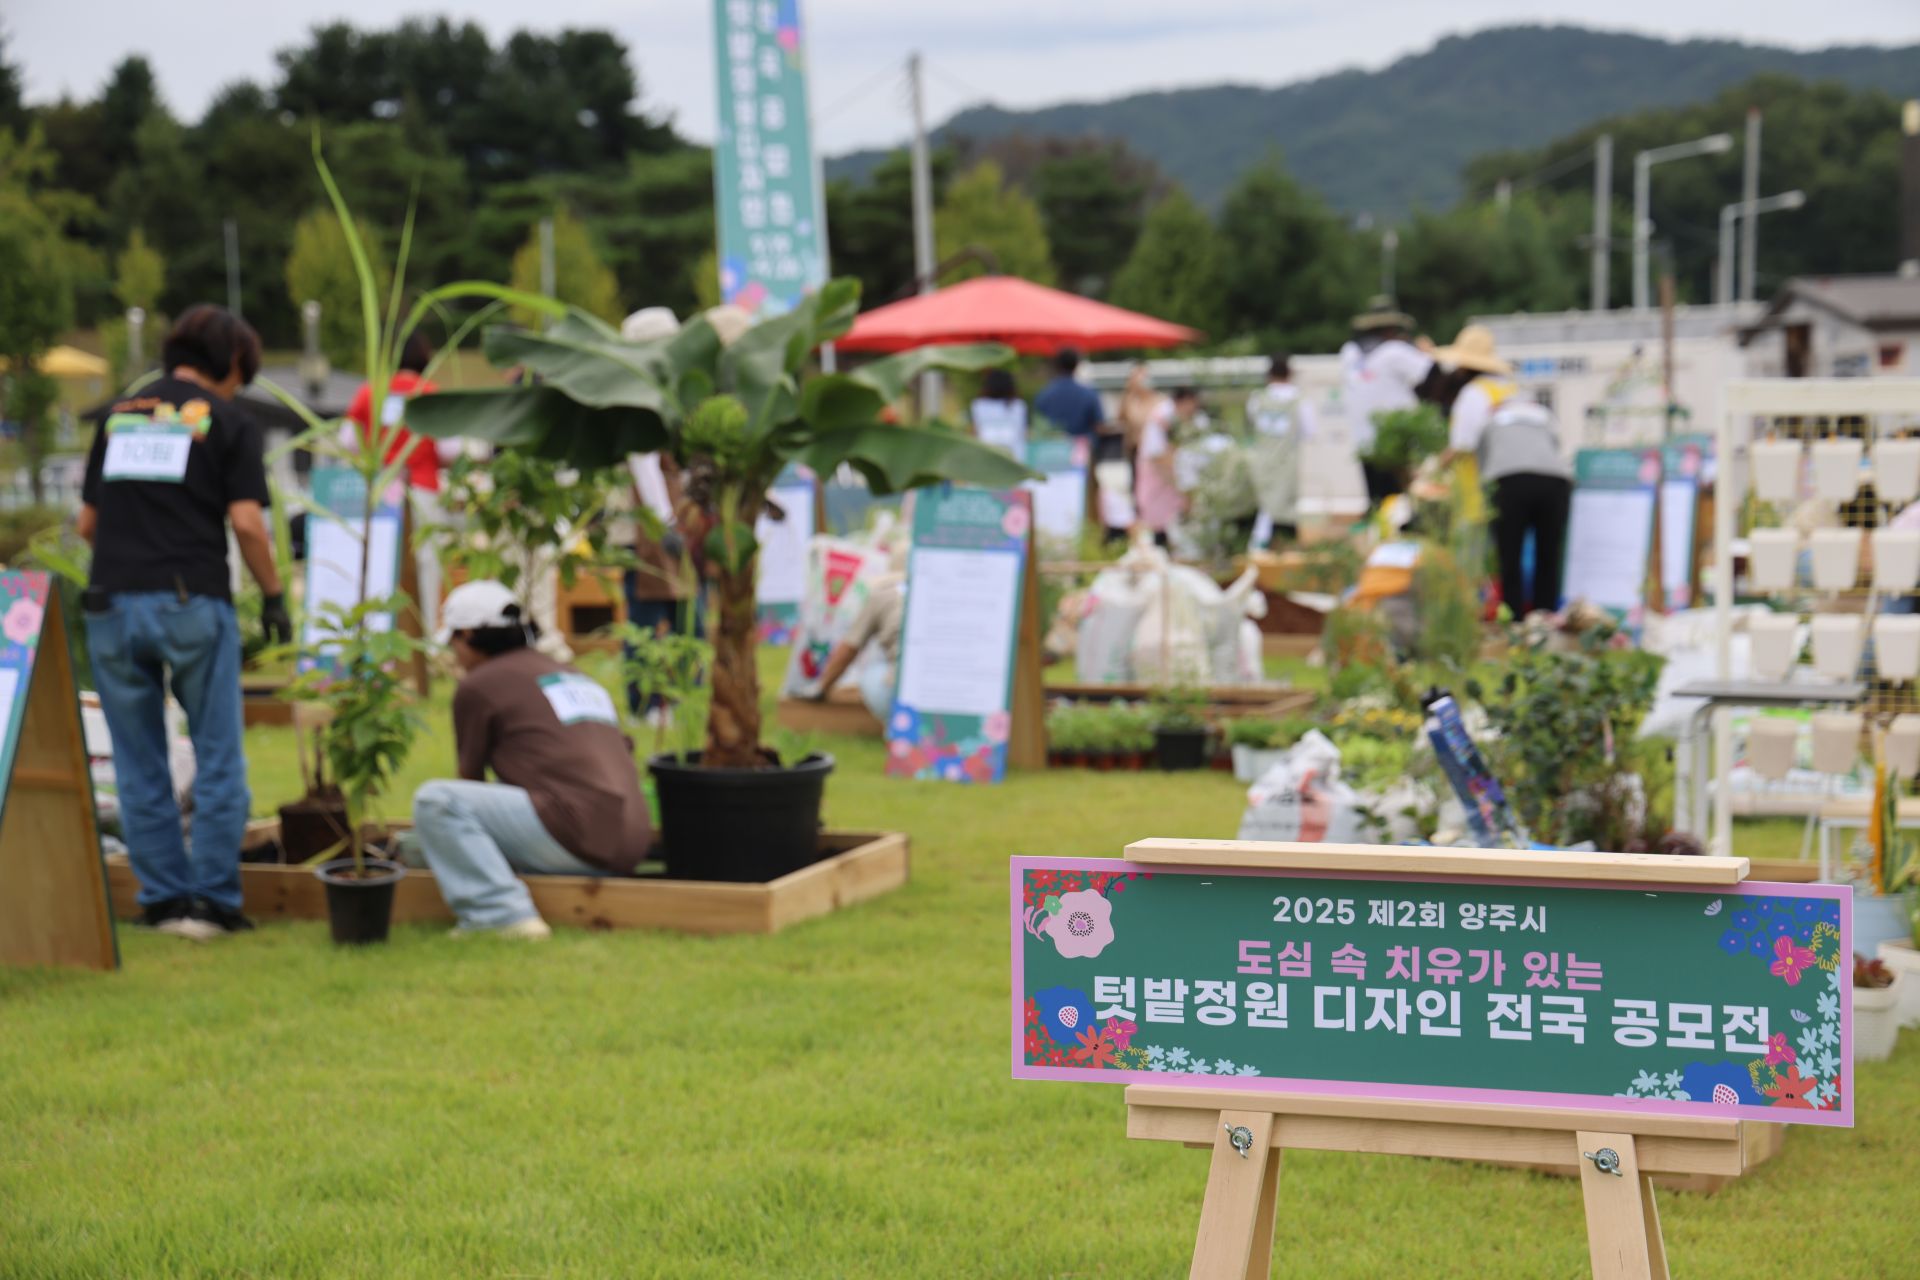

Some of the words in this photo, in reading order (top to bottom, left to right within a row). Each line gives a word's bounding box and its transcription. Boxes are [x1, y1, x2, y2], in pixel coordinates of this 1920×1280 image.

[1272, 896, 1356, 926] 2025
[1367, 899, 1446, 929] 제2회
[1458, 903, 1547, 933] 양주시
[1236, 939, 1313, 978] 도심
[1330, 942, 1367, 981] 속
[1385, 945, 1507, 987] 치유가
[1522, 951, 1604, 991] 있는
[1093, 975, 1289, 1029] 텃밭정원
[1313, 985, 1462, 1037] 디자인
[1487, 992, 1588, 1045] 전국
[1611, 998, 1770, 1054] 공모전
